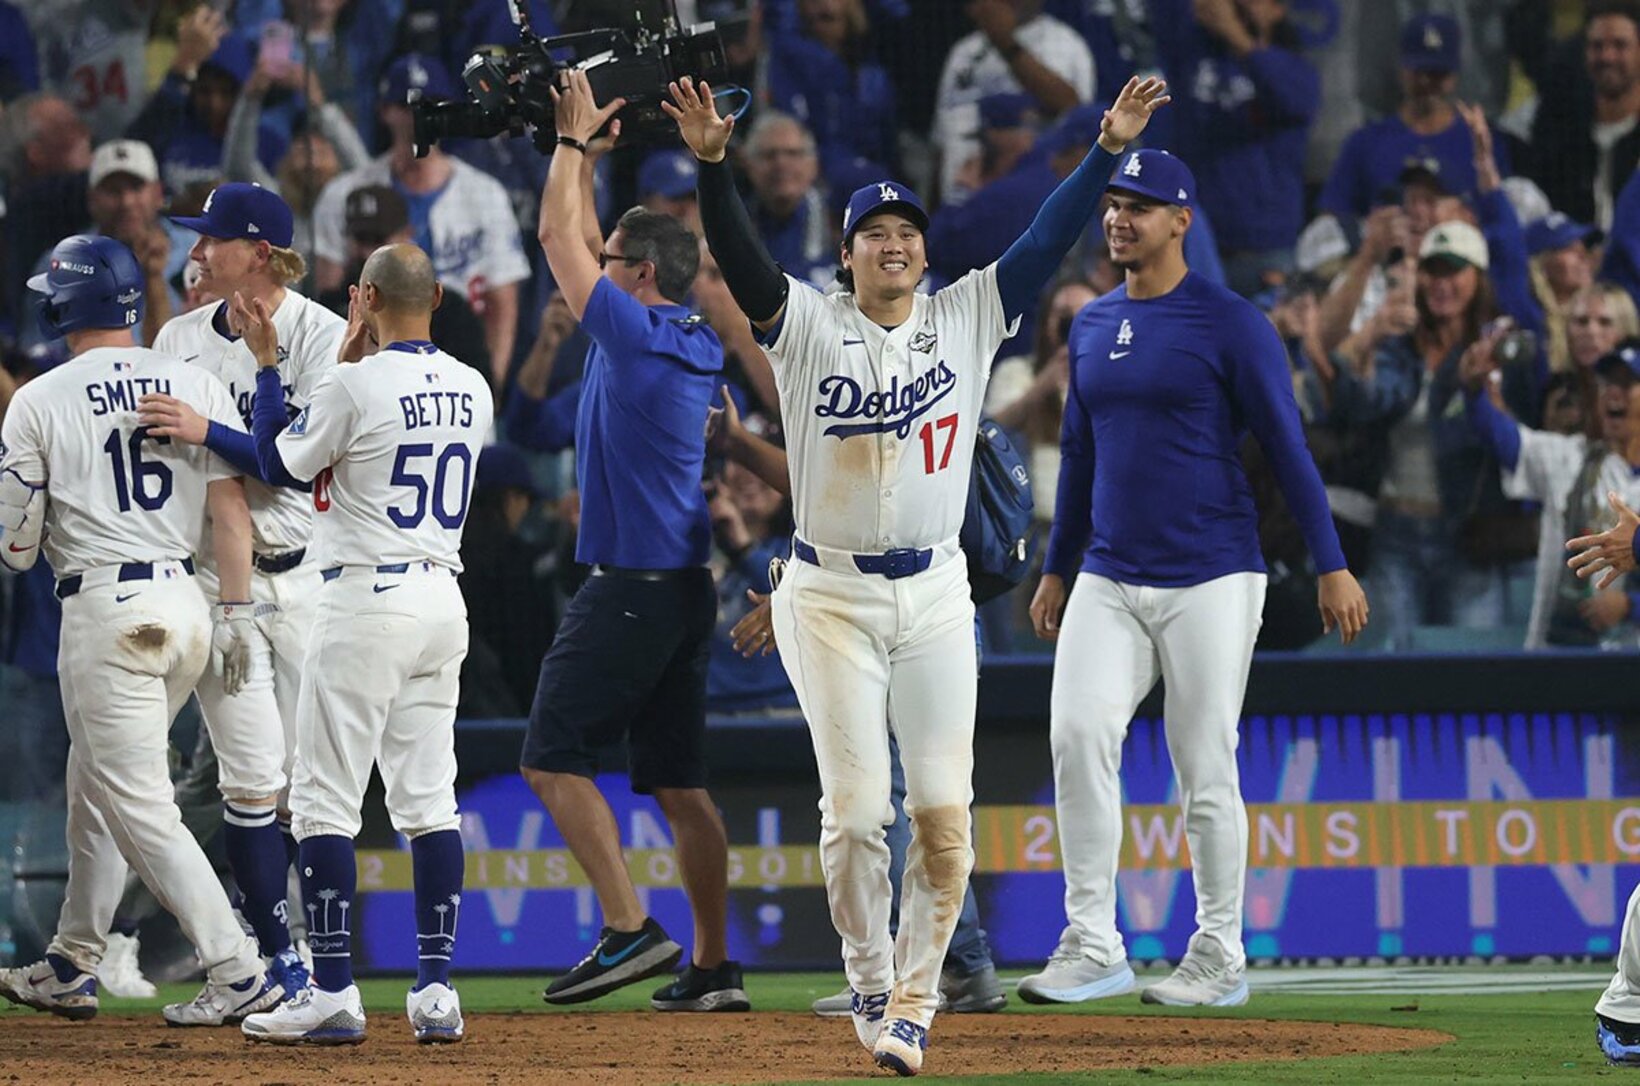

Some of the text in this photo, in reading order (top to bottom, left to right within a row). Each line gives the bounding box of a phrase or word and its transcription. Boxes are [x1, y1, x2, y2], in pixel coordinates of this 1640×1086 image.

[73, 57, 128, 109] 34
[878, 183, 900, 201] LA
[125, 309, 138, 325] 16
[86, 378, 171, 416] SMITH
[399, 392, 473, 430] BETTS
[815, 360, 956, 440] Dodgers
[104, 425, 173, 513] 16
[919, 413, 959, 475] 17
[387, 443, 472, 529] 50
[1024, 815, 1055, 863] 2
[1130, 811, 1361, 860] WNS
[1434, 808, 1537, 857] TO
[362, 855, 384, 885] 2
